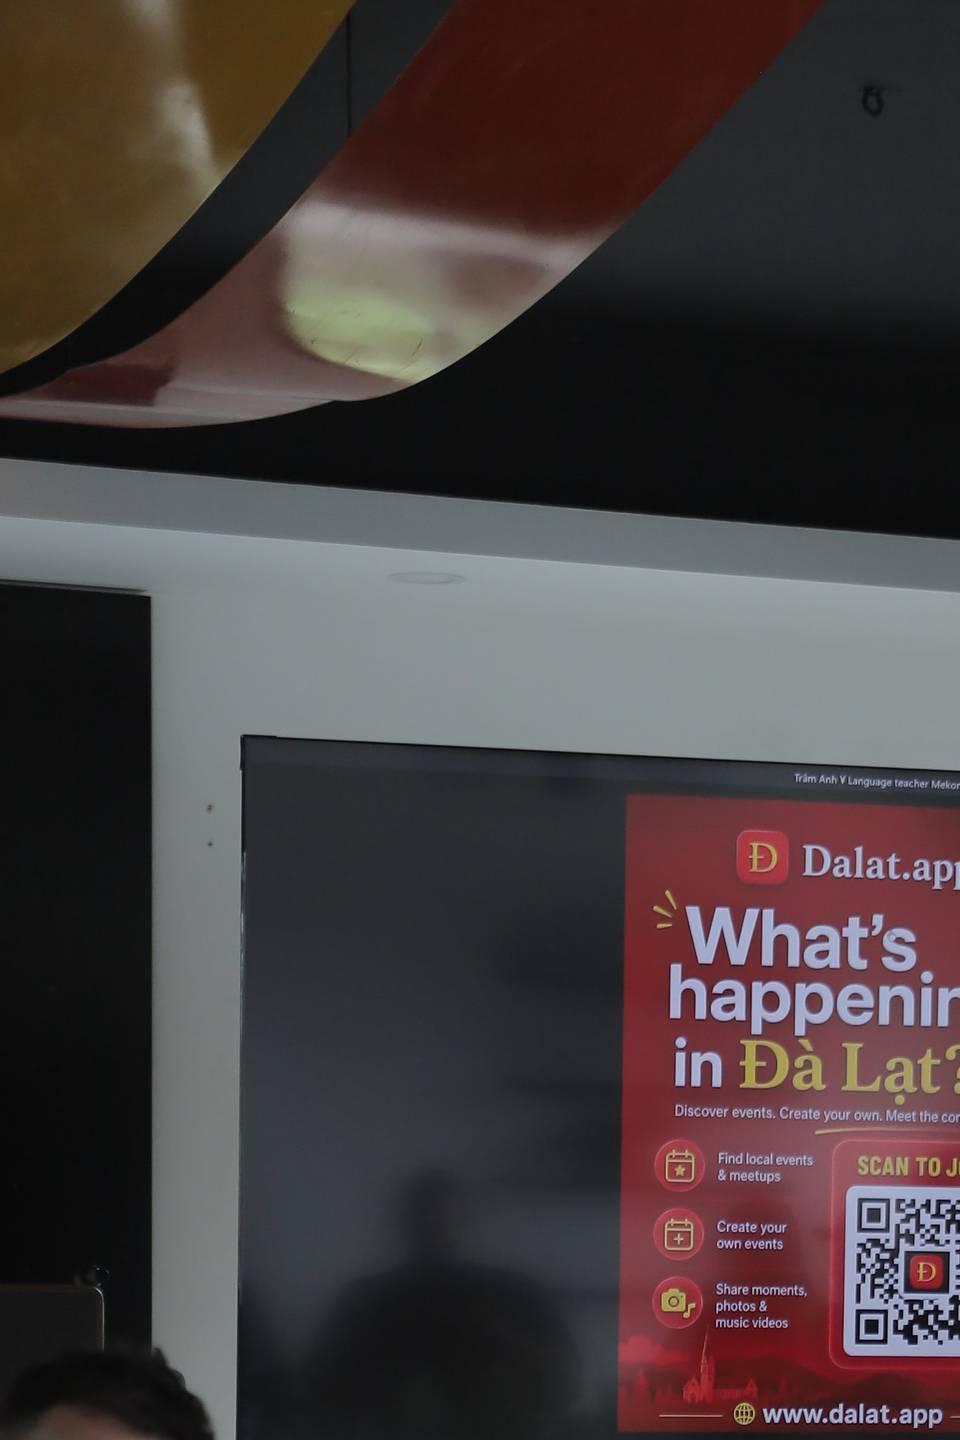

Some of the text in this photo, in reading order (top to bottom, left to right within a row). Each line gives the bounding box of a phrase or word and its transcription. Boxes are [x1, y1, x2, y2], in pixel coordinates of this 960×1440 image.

[818, 774, 837, 784] Anh
[848, 776, 892, 789] Language
[895, 778, 928, 789] teacher
[685, 905, 917, 972] What’s
[674, 1036, 723, 1087] in
[739, 1038, 826, 1091] Đà
[675, 1105, 728, 1119] Discover
[732, 1106, 776, 1120] events.
[779, 1107, 820, 1120] Create
[823, 1110, 851, 1123] your
[854, 1110, 882, 1122] own.
[886, 1109, 915, 1123] Meet
[918, 1110, 939, 1123] the
[718, 1153, 813, 1167] Find local events
[857, 1156, 909, 1176] SCAN
[916, 1157, 940, 1177] TO
[717, 1169, 781, 1184] & meetups
[717, 1221, 787, 1237] Create your
[716, 1238, 784, 1251] own events
[716, 1283, 807, 1298] Share moments,
[715, 1300, 768, 1315] photos &
[715, 1316, 788, 1329] music videos
[763, 1403, 943, 1429] www.dalat.app
